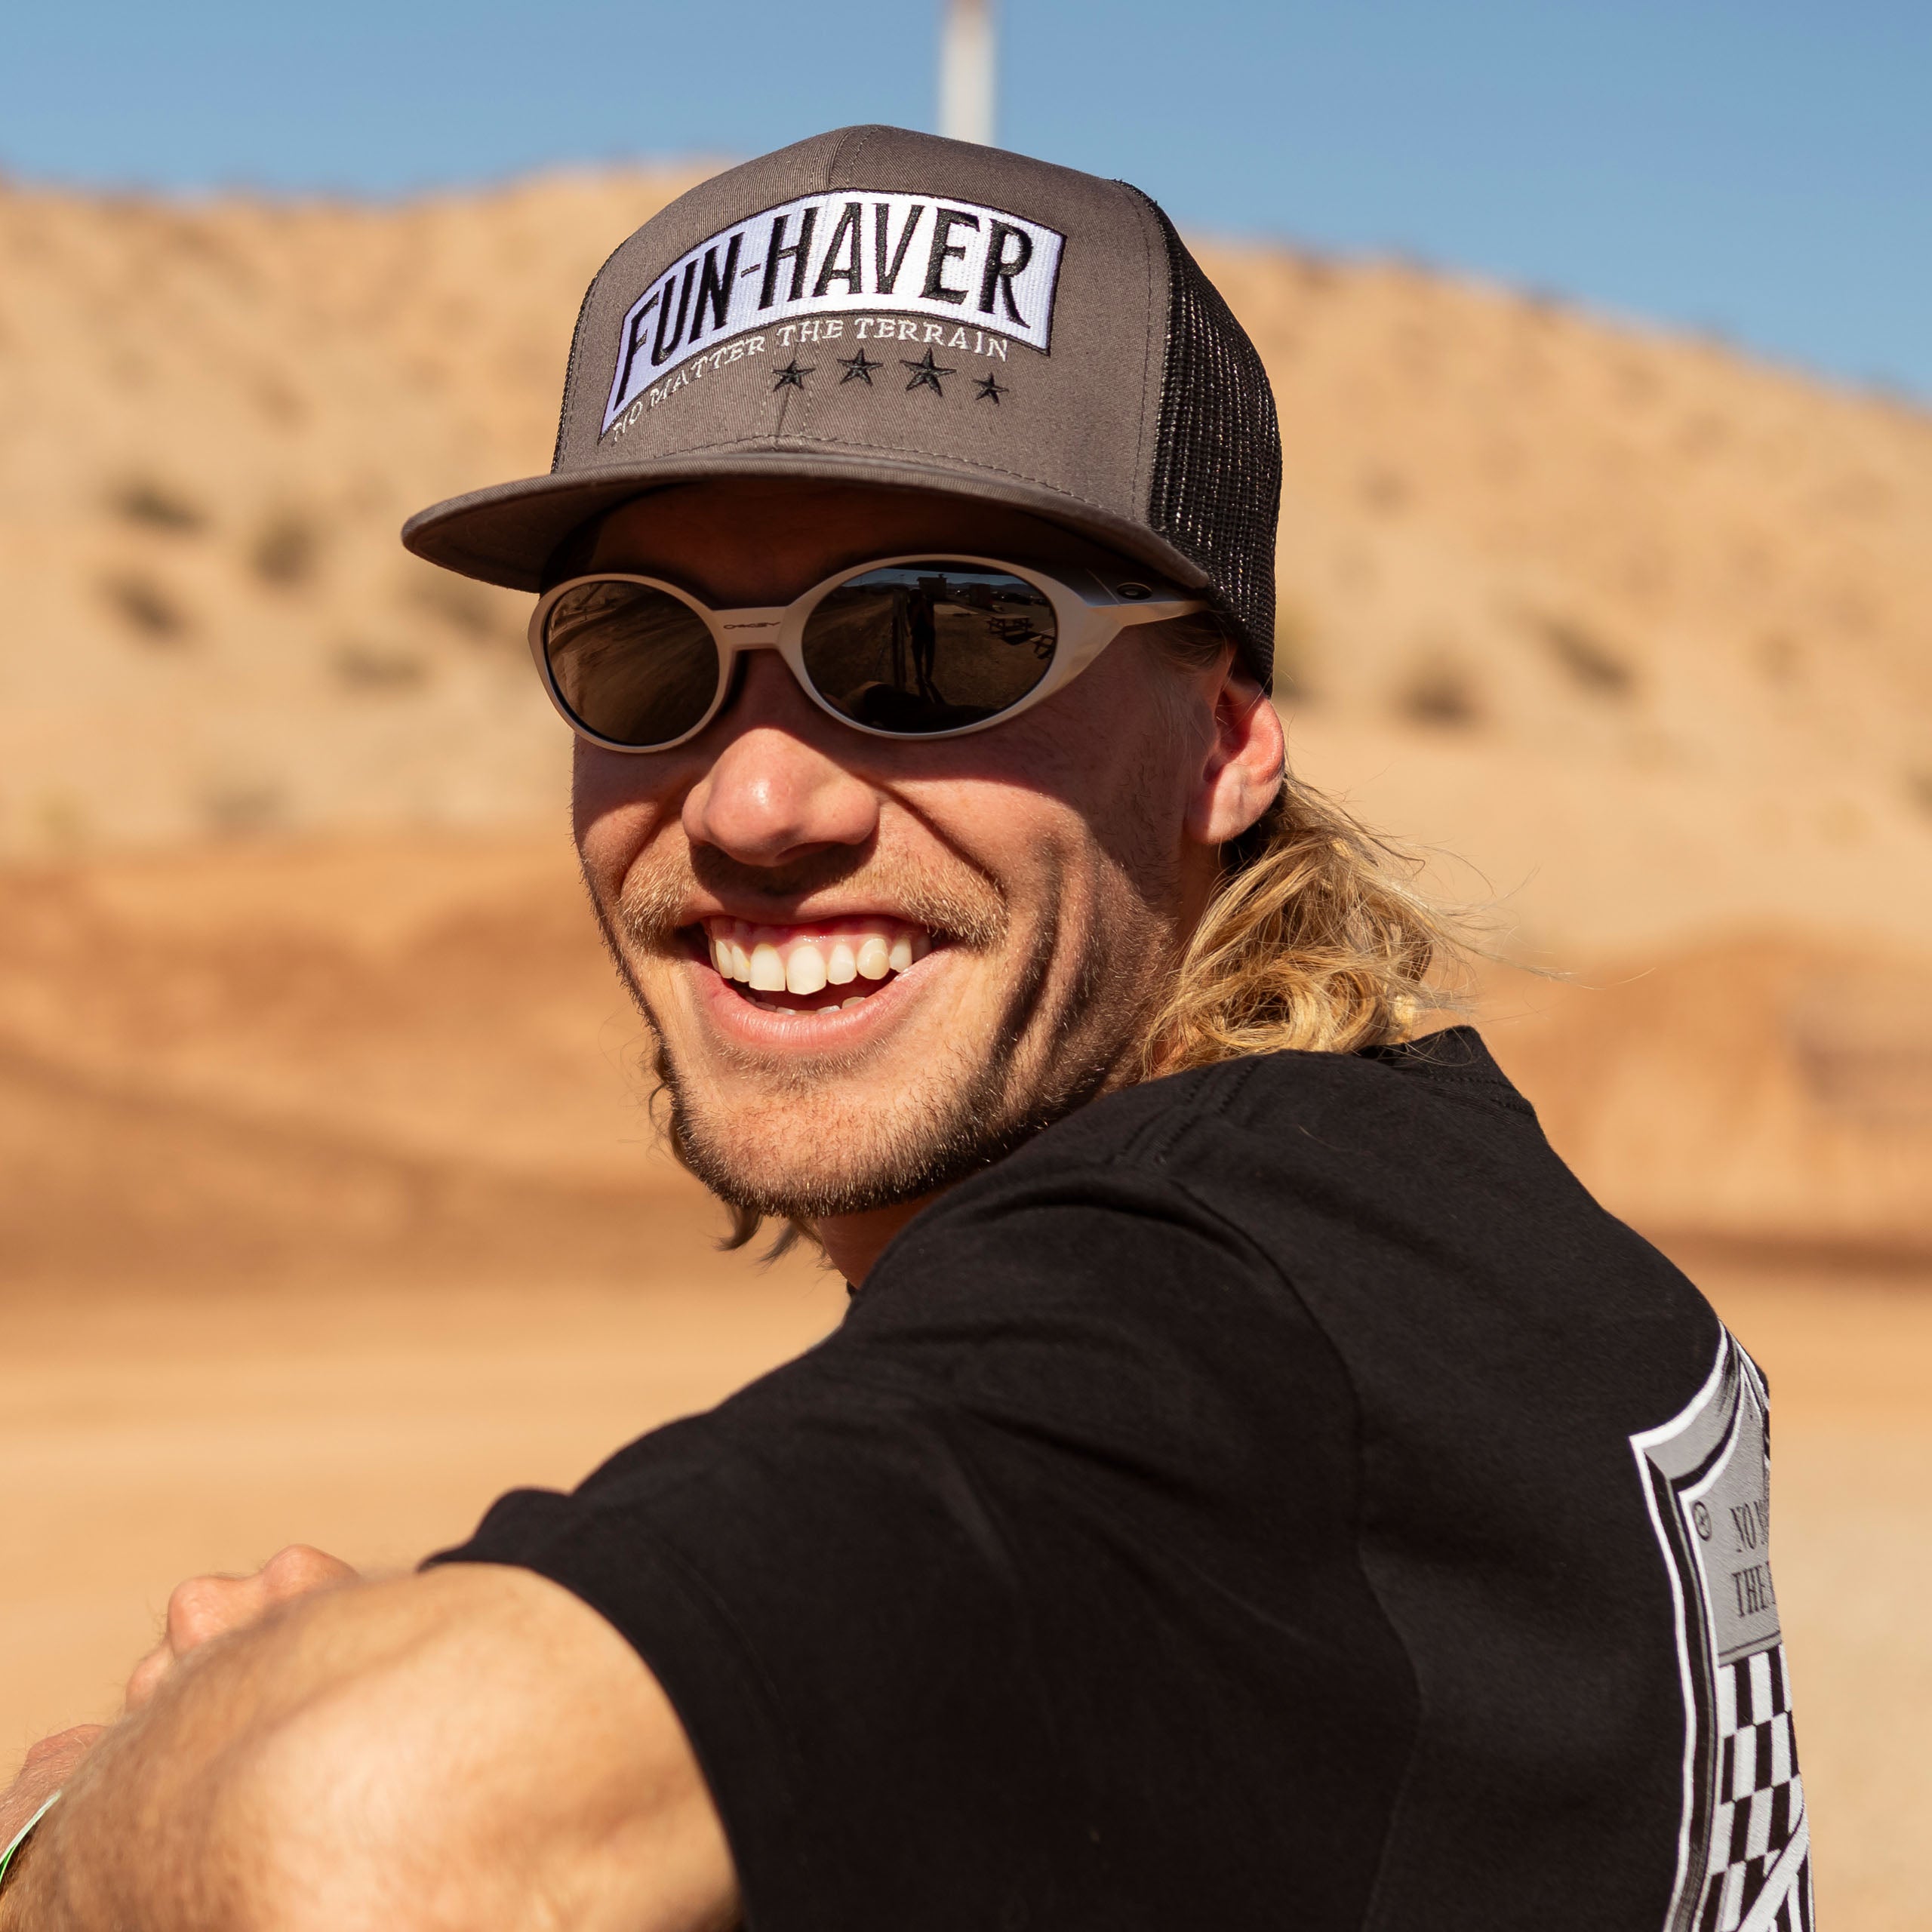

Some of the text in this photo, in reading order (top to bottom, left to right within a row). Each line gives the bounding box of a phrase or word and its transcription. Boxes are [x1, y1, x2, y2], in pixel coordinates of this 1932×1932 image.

[614, 201, 1032, 411] FUN-HAVER
[613, 317, 1008, 442] NO MATTER THE TERRAIN
[1729, 1502, 1757, 1552] NO
[1731, 1564, 1769, 1619] THE
